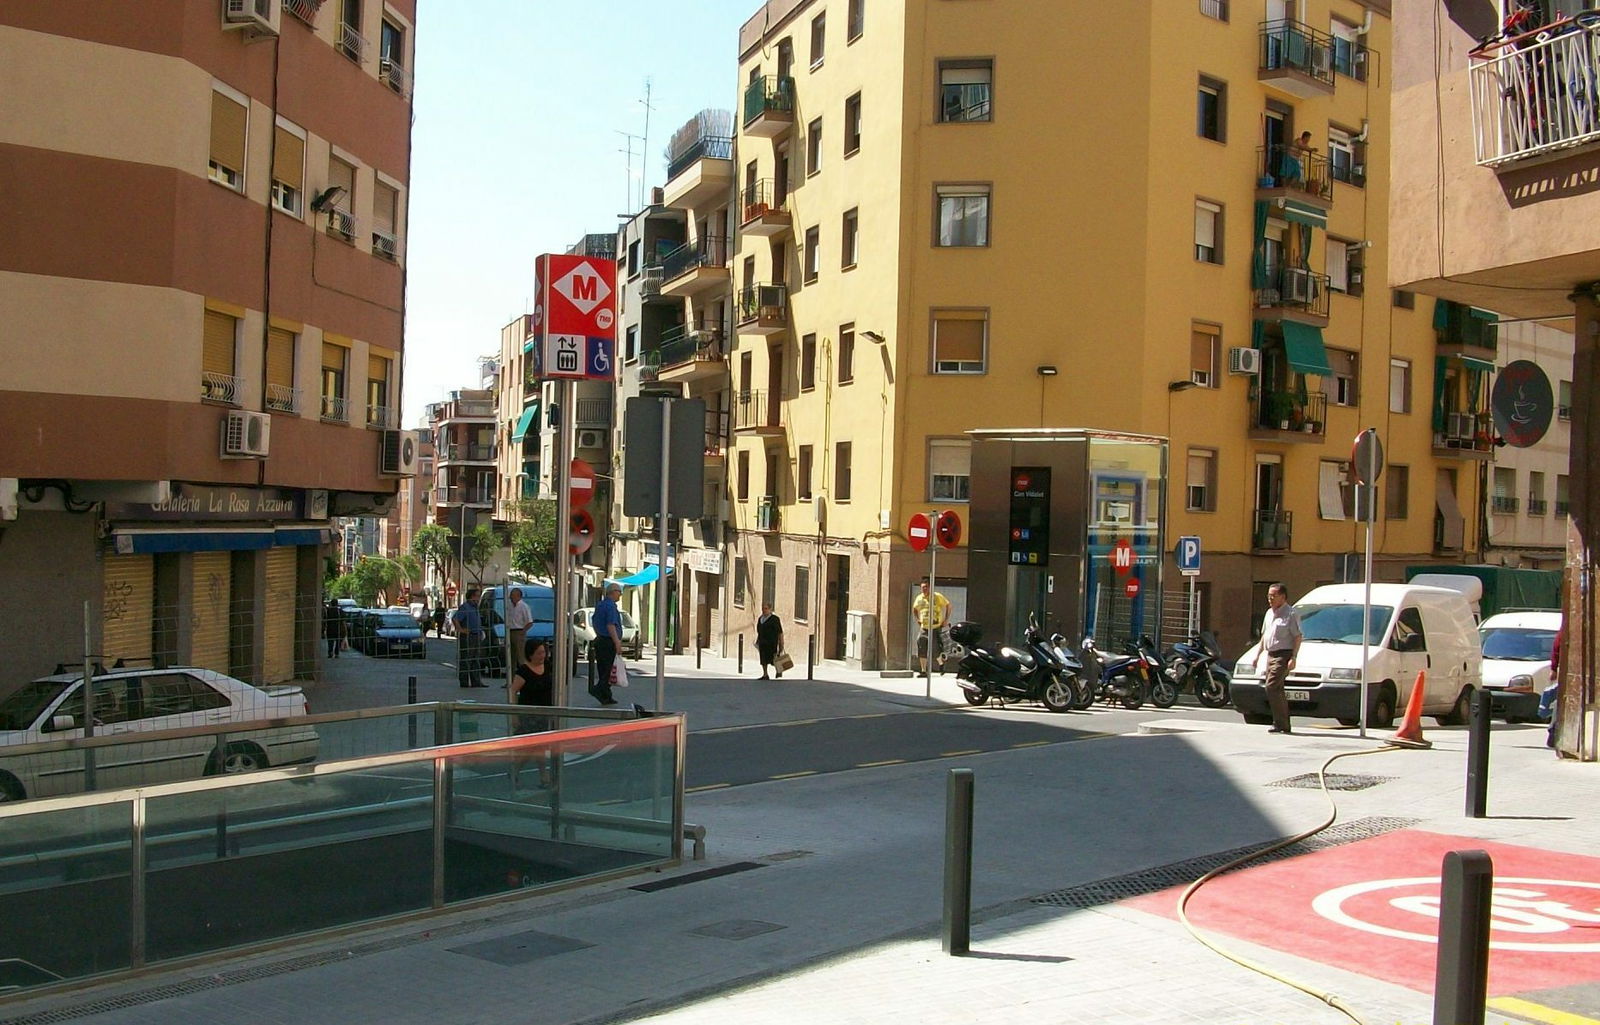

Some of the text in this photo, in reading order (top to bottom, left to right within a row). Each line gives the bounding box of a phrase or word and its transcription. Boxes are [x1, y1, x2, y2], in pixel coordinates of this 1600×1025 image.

[572, 274, 598, 301] M
[209, 491, 223, 513] La
[228, 491, 250, 513] Rosa
[1116, 547, 1130, 567] M
[1185, 541, 1197, 566] P
